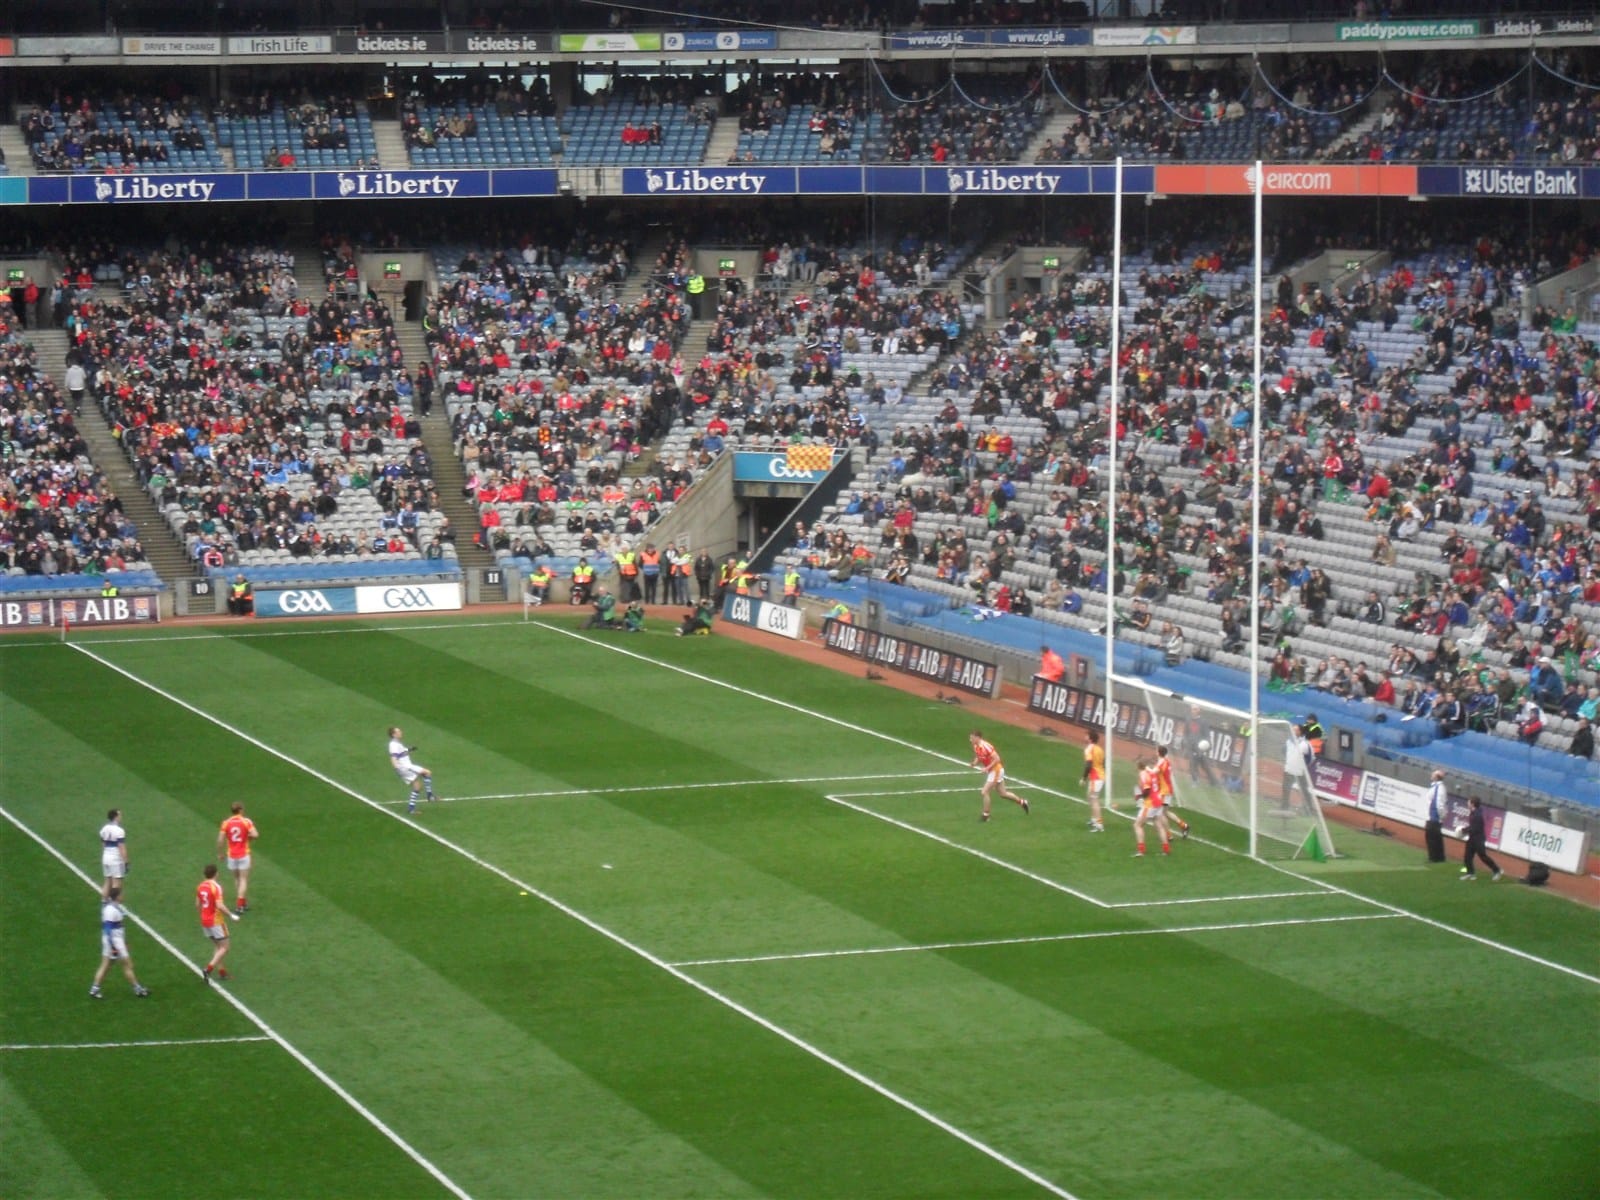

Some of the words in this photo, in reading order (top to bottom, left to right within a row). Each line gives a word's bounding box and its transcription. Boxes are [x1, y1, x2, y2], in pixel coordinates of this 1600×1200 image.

[908, 33, 964, 46] www.cgl.ie
[1008, 31, 1065, 45] www.cgl.ie
[1341, 22, 1474, 40] paddypower.com
[1494, 20, 1542, 36] tickets.ie
[169, 42, 184, 50] THE
[251, 38, 281, 53] Irish
[284, 38, 308, 52] Life
[357, 37, 427, 51] tickets.ie
[467, 37, 537, 50] tickets.ie
[686, 38, 714, 46] ZURICH
[741, 37, 768, 45] ZURICH
[113, 177, 215, 201] Liberty
[357, 174, 459, 197] Liberty
[664, 170, 766, 194] Liberty
[964, 169, 1061, 194] Liberty
[1483, 169, 1532, 194] Ulster
[1535, 170, 1577, 194] Bank
[278, 589, 334, 613] GAA
[383, 587, 434, 609] GAA
[83, 599, 130, 622] AIB
[835, 624, 857, 651] AIB
[875, 636, 898, 663] AIB
[917, 648, 940, 676] AIB
[960, 661, 985, 690] AIB
[1041, 684, 1067, 715] AIB
[1145, 714, 1175, 746] AIB
[230, 826, 242, 842] 2
[1517, 827, 1562, 854] keenan
[200, 891, 209, 908] 3
